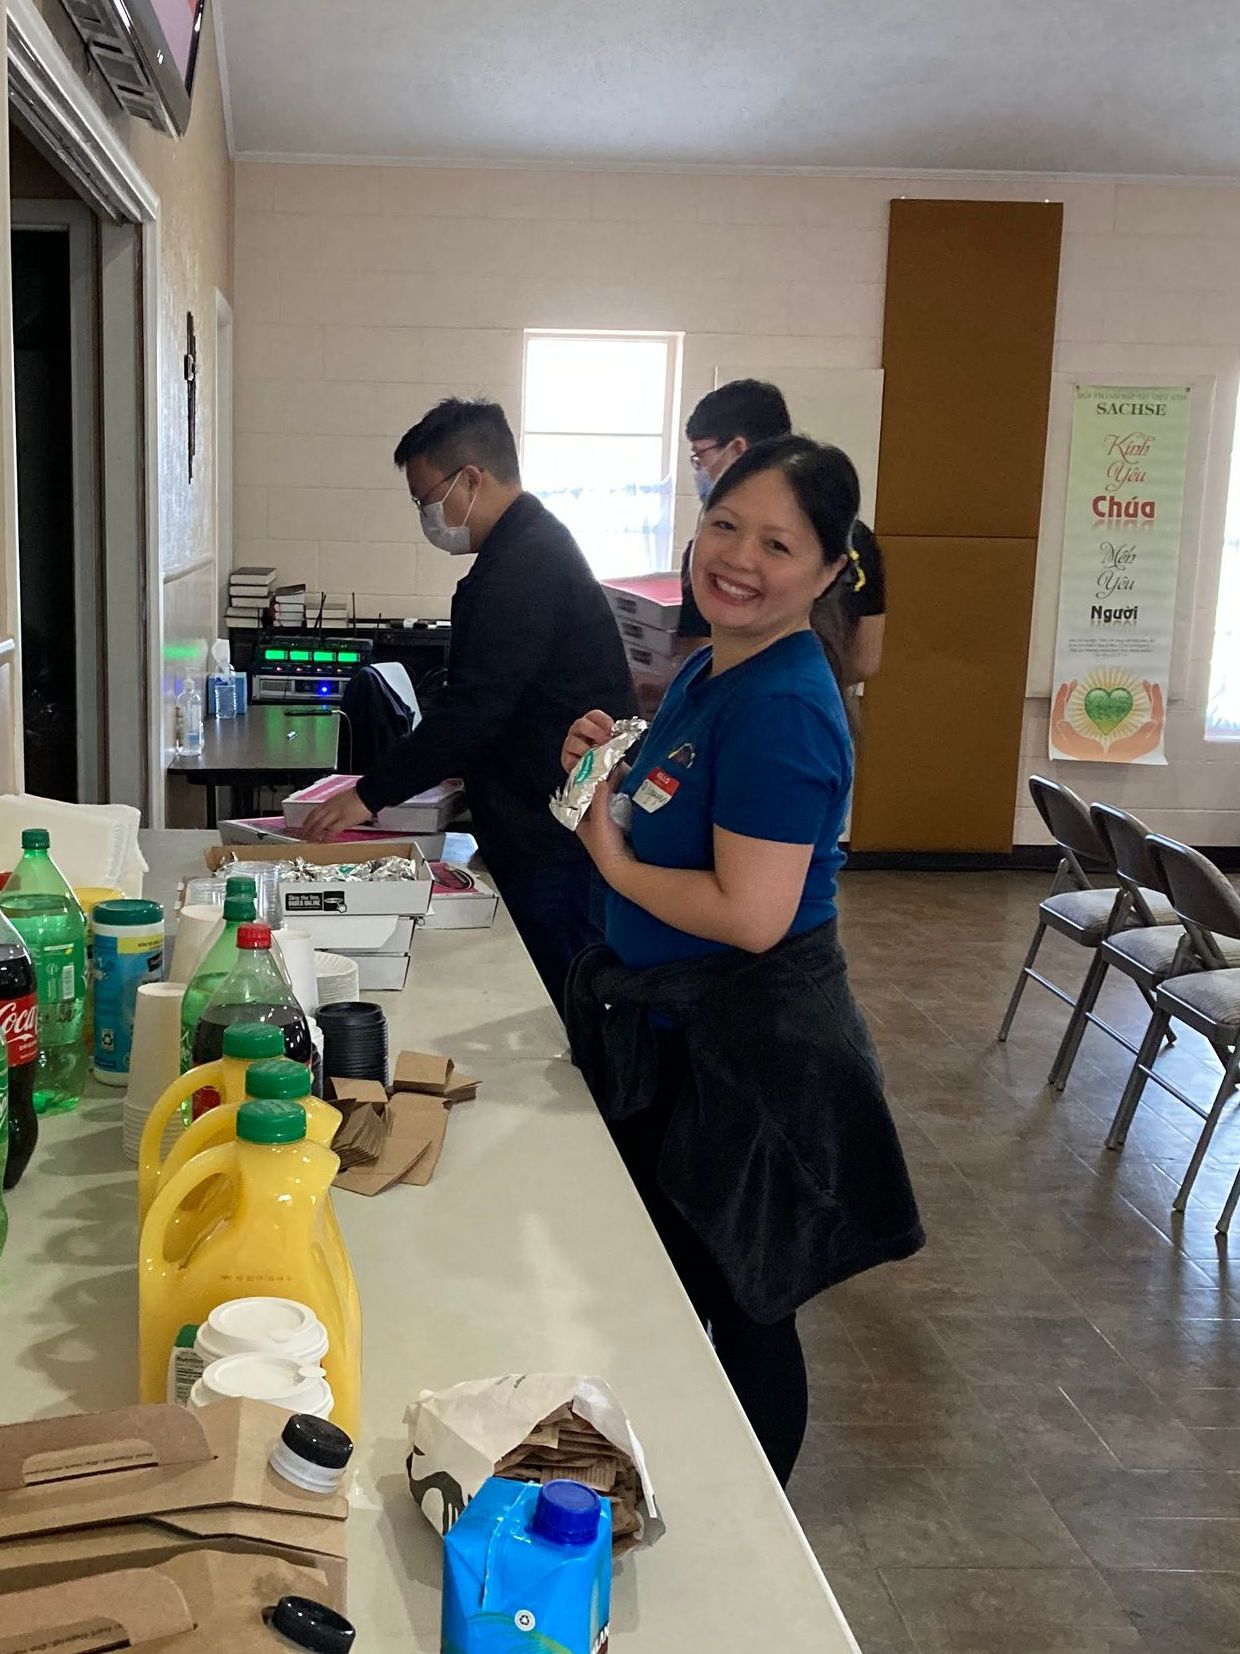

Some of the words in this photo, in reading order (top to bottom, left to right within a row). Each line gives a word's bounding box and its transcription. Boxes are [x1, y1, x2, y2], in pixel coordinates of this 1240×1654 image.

[1096, 402, 1167, 416] SACHSE
[1104, 432, 1155, 464] Kính
[1092, 495, 1155, 518] Chúa
[1090, 605, 1138, 623] Người
